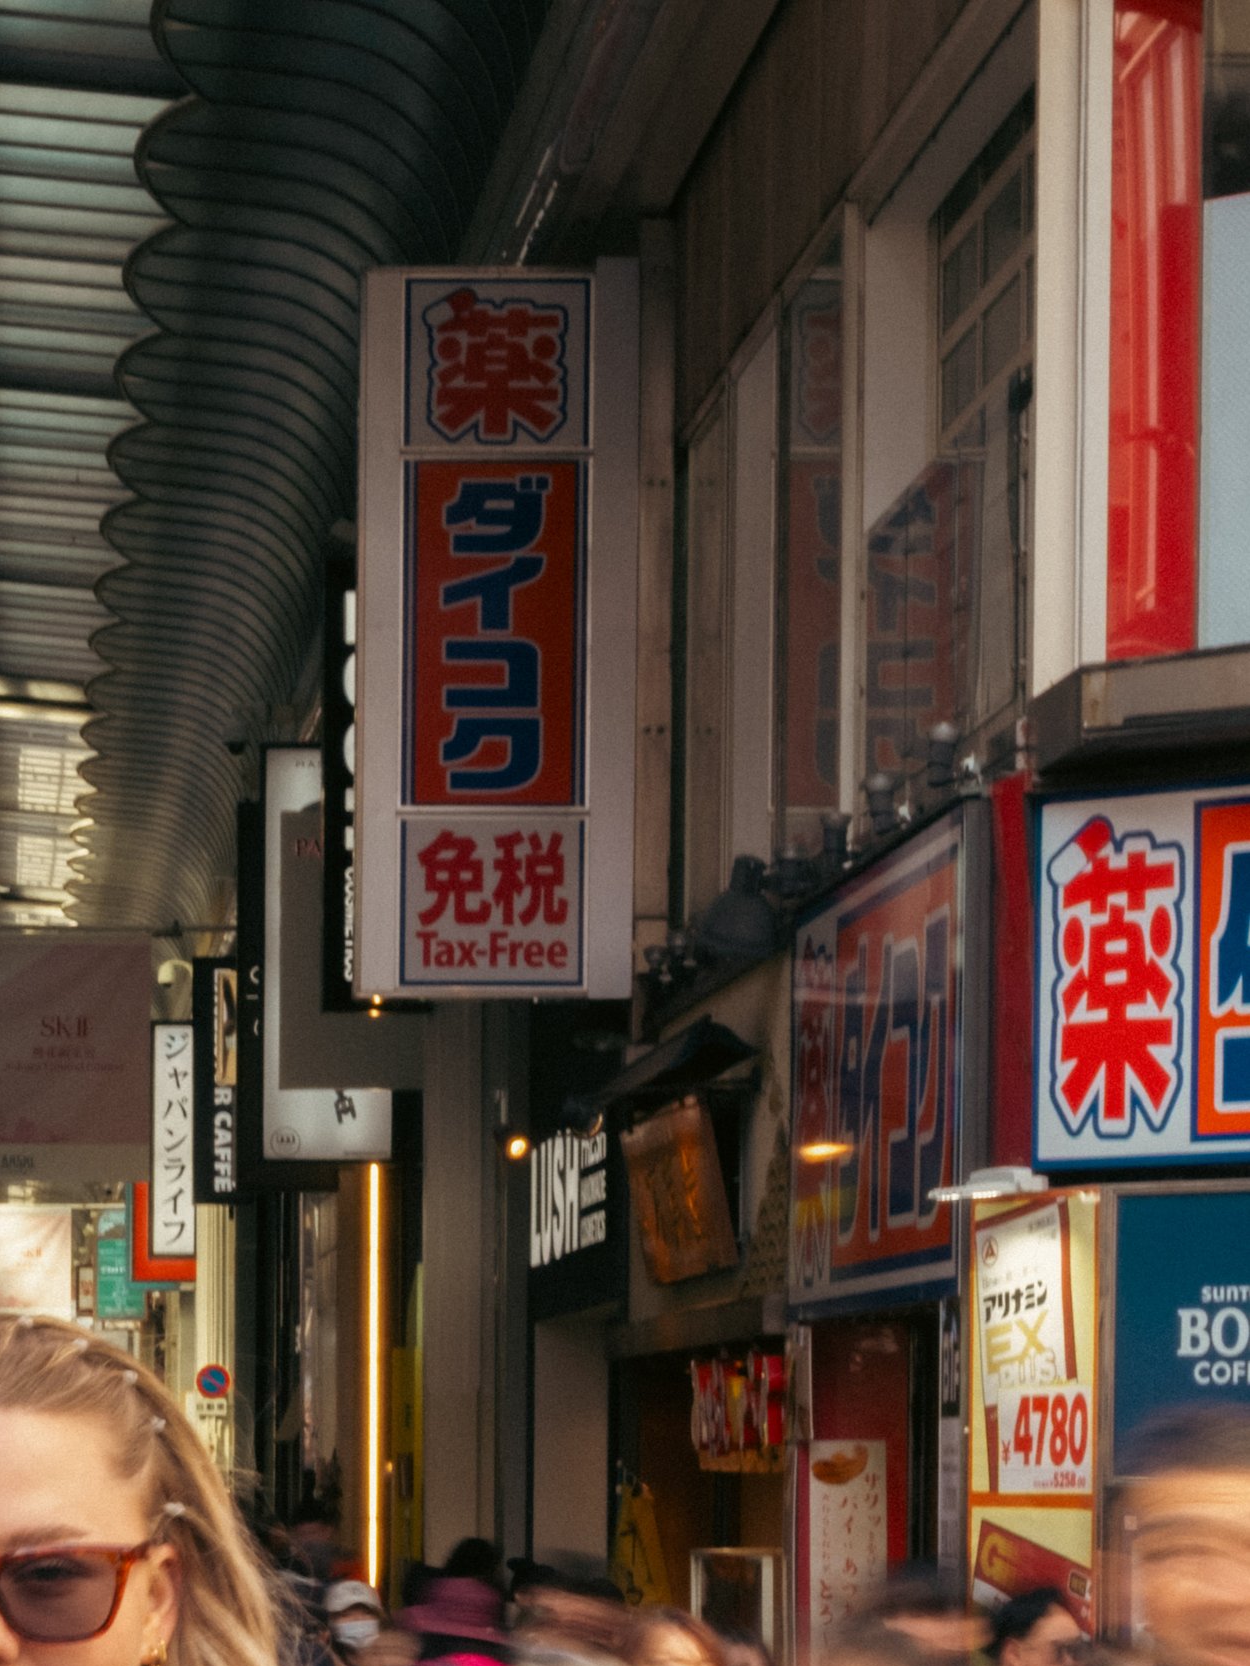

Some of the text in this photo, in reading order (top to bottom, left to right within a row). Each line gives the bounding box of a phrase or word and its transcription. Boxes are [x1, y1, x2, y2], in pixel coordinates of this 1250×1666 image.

[422, 288, 568, 445] 薬
[440, 474, 547, 793] ダイコク
[416, 830, 568, 928] 免税
[416, 931, 568, 969] Tax-Free
[1048, 814, 1185, 1139] 薬
[530, 1127, 580, 1268] LUSH
[983, 1280, 1048, 1323] アリナミン
[1177, 1306, 1250, 1358] BO
[1193, 1360, 1250, 1386] COF
